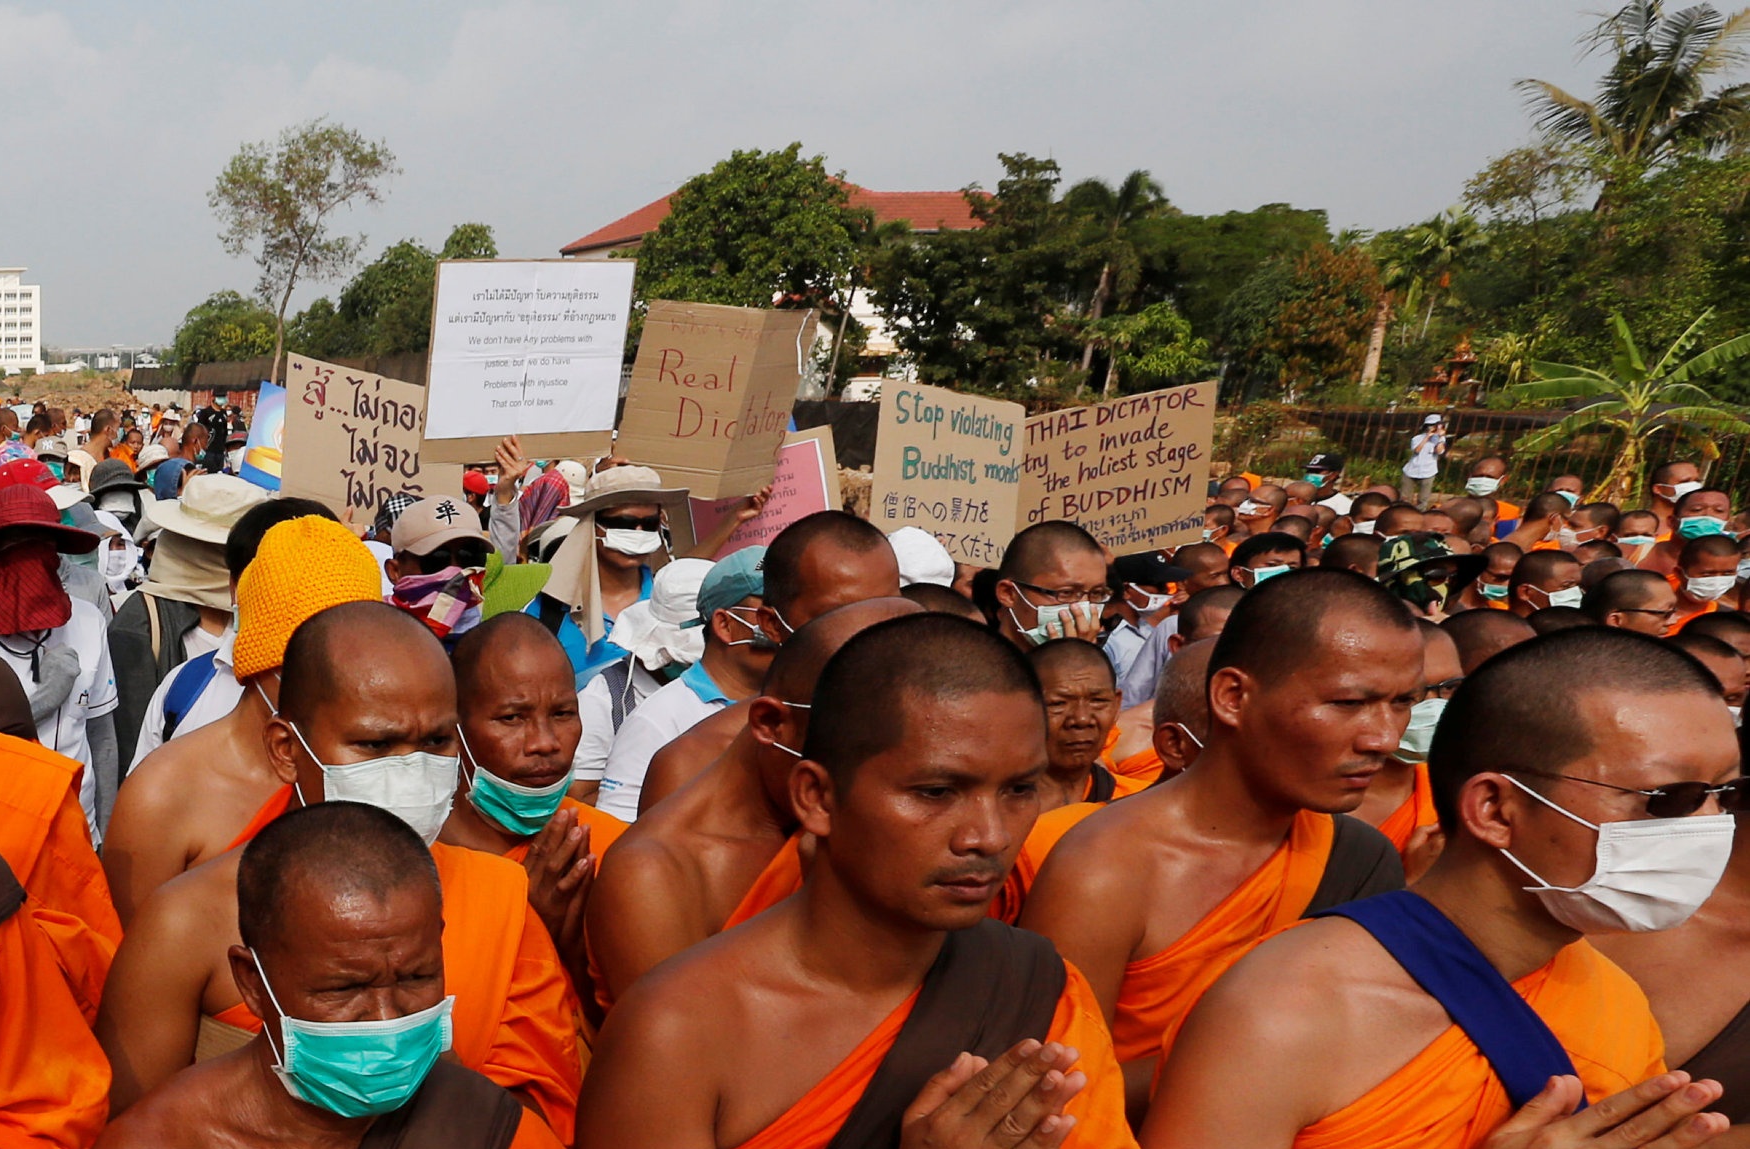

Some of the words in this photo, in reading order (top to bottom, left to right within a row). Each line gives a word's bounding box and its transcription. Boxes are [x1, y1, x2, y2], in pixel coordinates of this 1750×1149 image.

[469, 335, 482, 345] We
[503, 335, 522, 344] have
[523, 334, 537, 346] Any
[540, 334, 575, 346] problems
[577, 334, 594, 344] with
[540, 357, 550, 366] do
[483, 379, 518, 390] Problems
[537, 378, 569, 389] injustice
[658, 348, 737, 393] Real
[491, 399, 508, 408] That
[895, 390, 944, 440] Stop
[951, 404, 1014, 457] violating
[1025, 409, 1088, 446] THAI
[1096, 387, 1205, 427] DICTATOR
[902, 445, 977, 485] Buddhist
[1021, 453, 1048, 479] try
[1062, 441, 1087, 461] to
[1099, 416, 1174, 452] invade
[1043, 473, 1071, 493] the
[1078, 449, 1138, 485] holiest
[1146, 441, 1202, 473] stage
[1028, 497, 1050, 524] of
[1062, 473, 1192, 519] BUDDHISM
